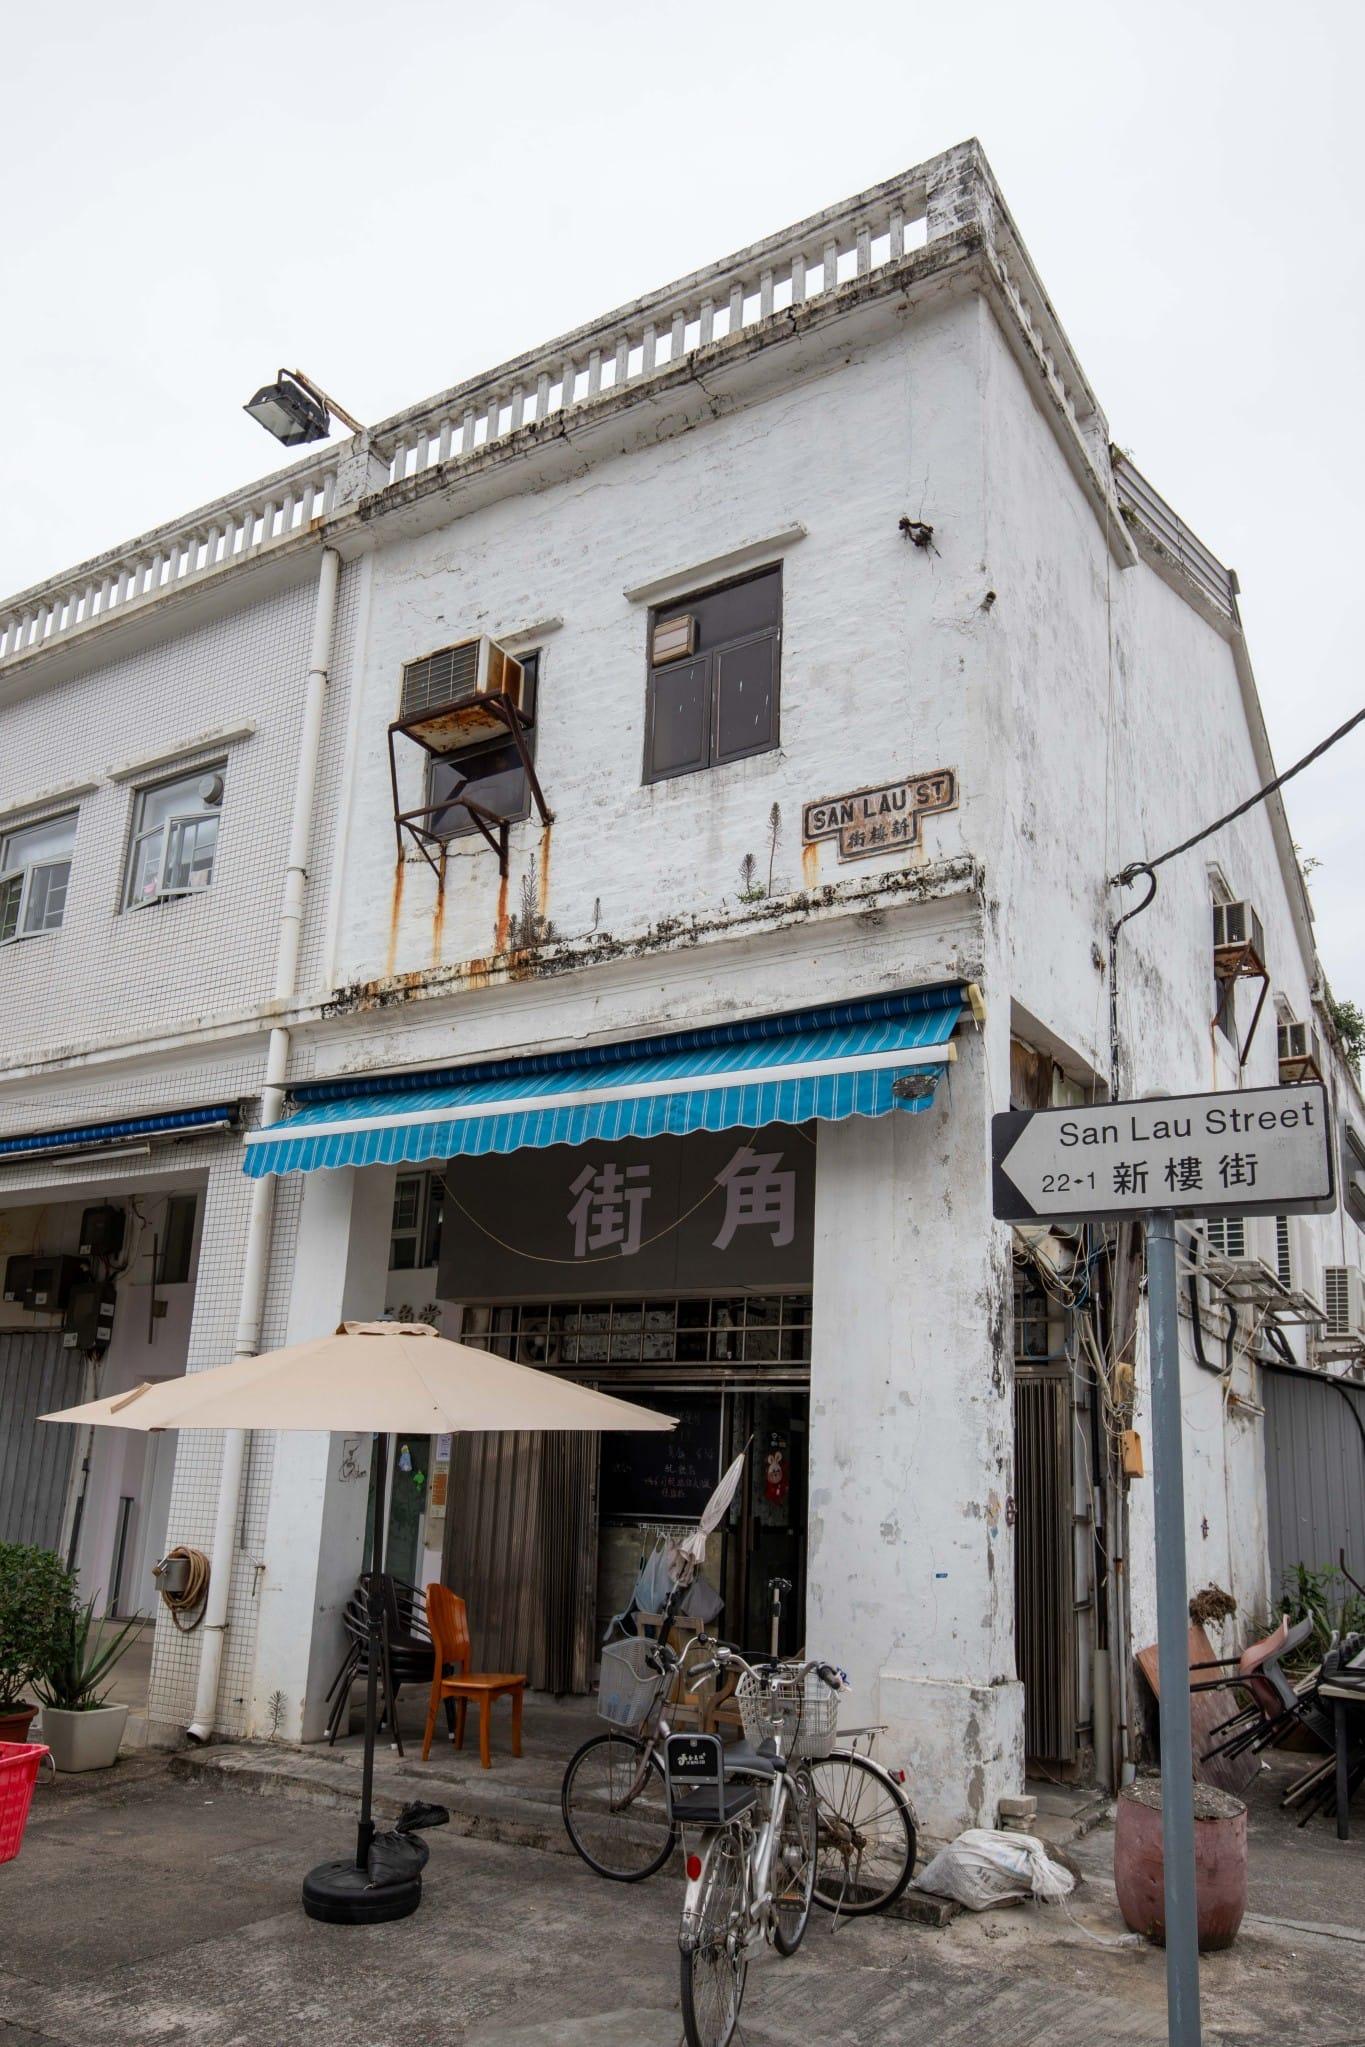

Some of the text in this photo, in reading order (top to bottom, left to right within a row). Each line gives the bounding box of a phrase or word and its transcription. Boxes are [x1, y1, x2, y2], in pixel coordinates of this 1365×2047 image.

[813, 803, 854, 830] SAN
[863, 789, 906, 818] LAU
[1059, 1101, 1315, 1147] San Lau Street
[1112, 1153, 1258, 1195] 新樓街
[567, 1146, 797, 1257] 街角
